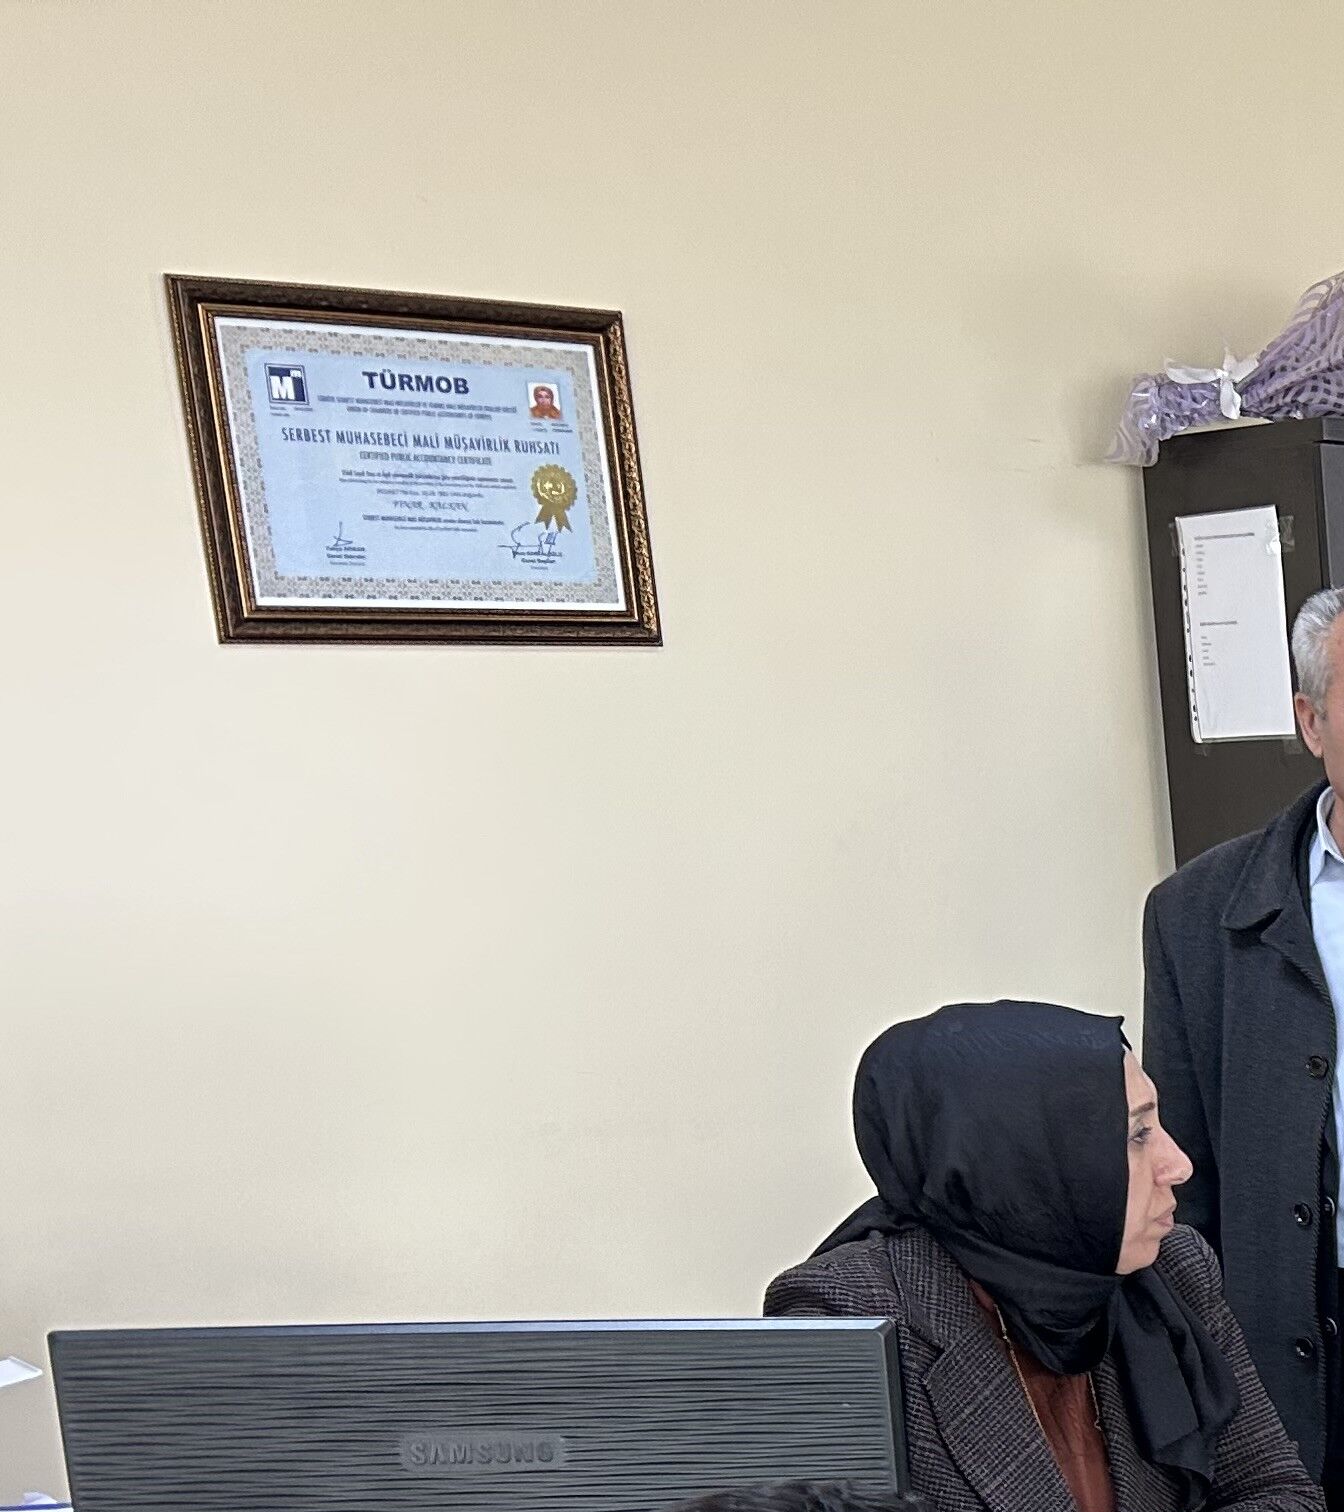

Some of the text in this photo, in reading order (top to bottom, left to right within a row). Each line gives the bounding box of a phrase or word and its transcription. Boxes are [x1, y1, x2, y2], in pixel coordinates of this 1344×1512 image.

[361, 368, 470, 395] TÜRMOB
[281, 426, 331, 443] SERBEST
[412, 432, 440, 448] MALİ
[514, 439, 560, 455] RUHSATI
[410, 1440, 555, 1466] SAMSUNG
